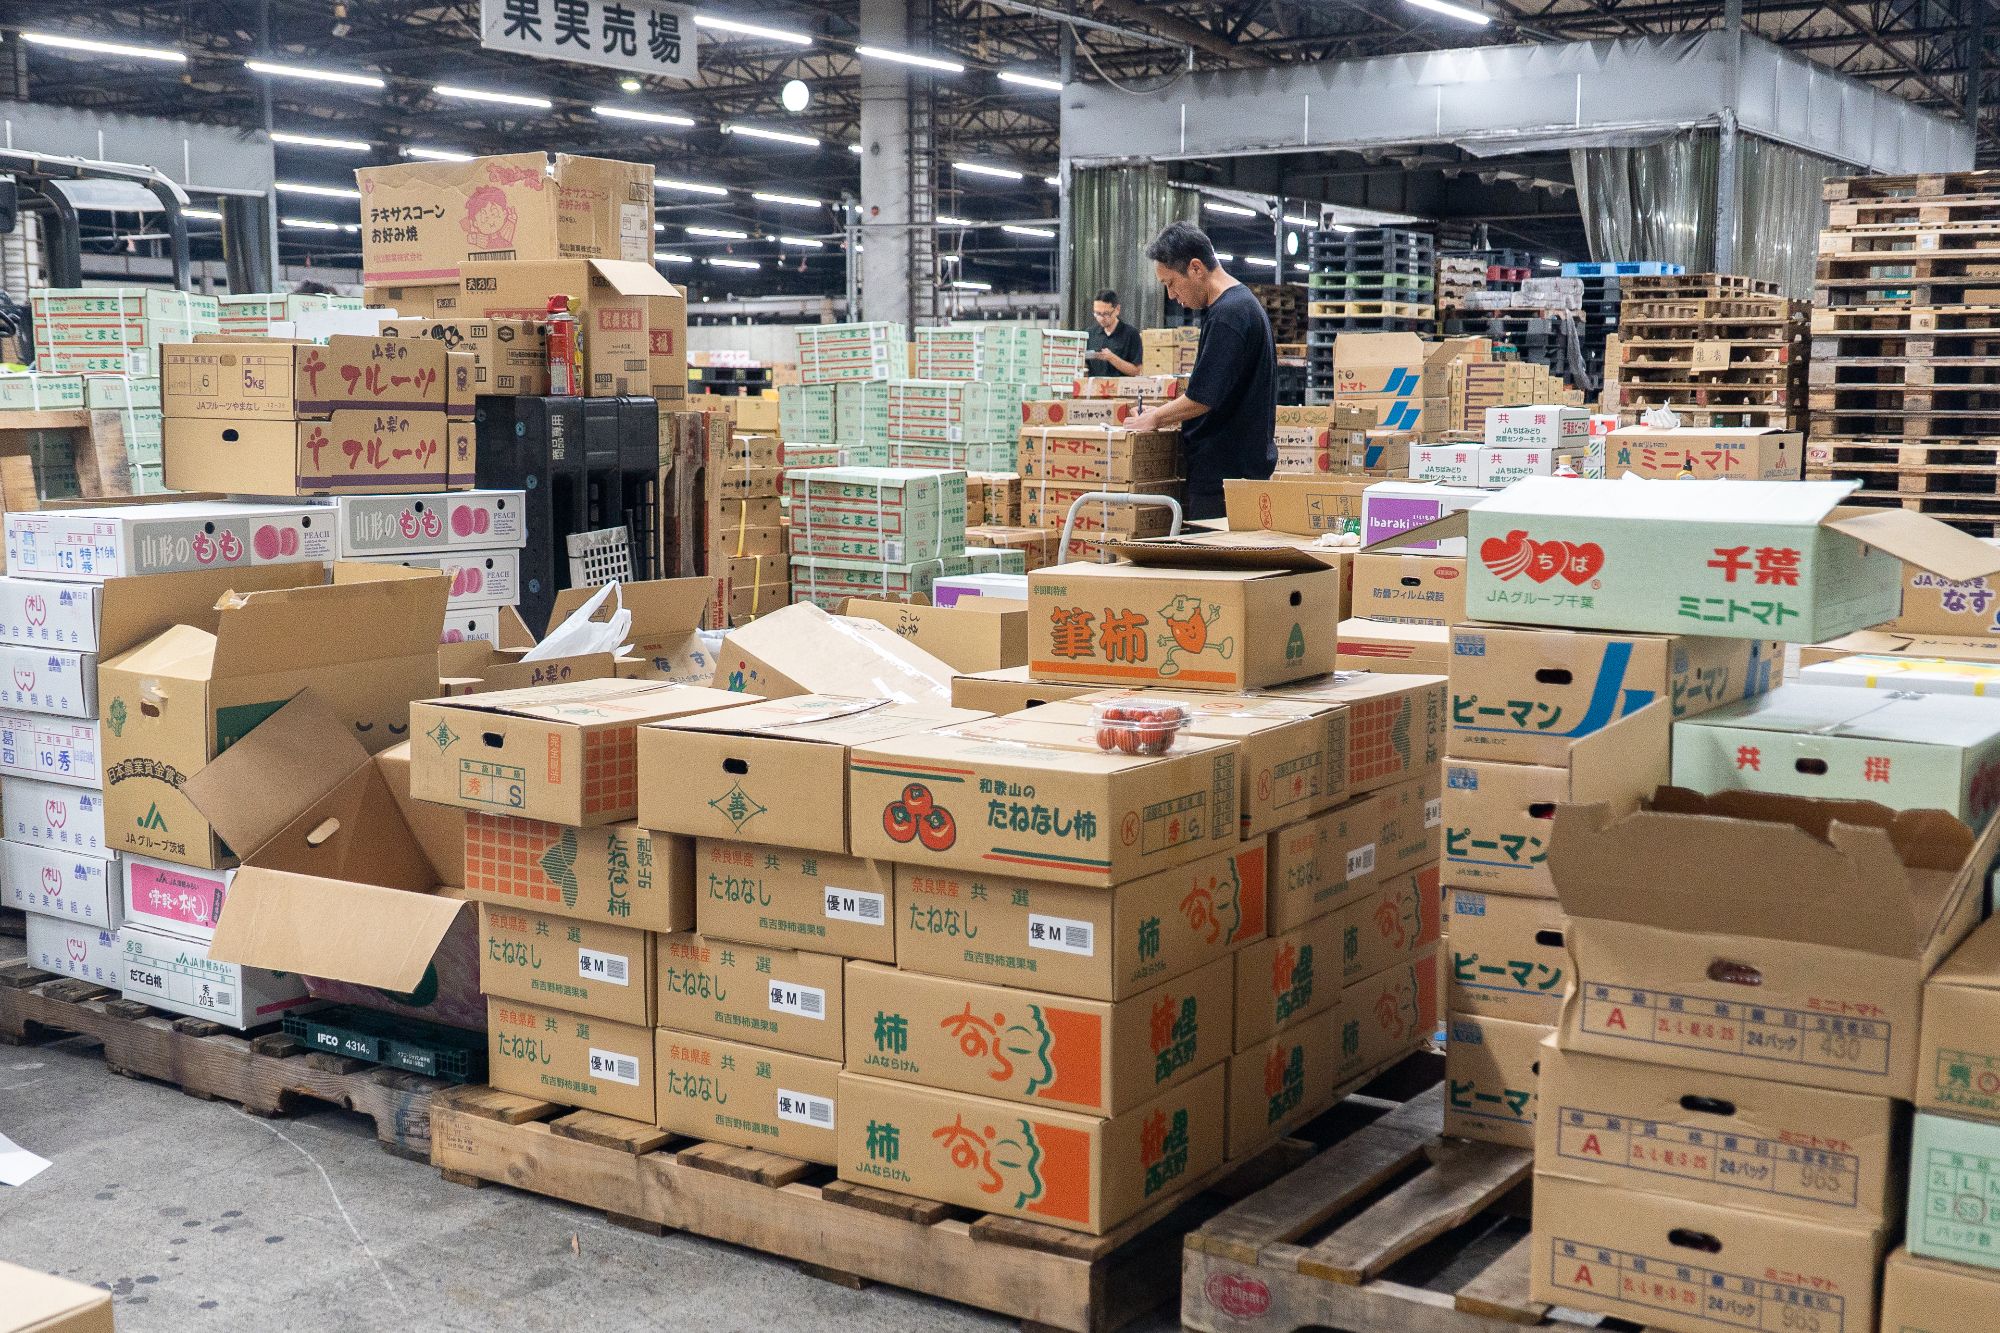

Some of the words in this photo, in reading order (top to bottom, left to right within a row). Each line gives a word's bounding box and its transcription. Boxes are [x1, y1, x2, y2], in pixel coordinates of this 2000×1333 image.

[503, 0, 681, 64] 果実売場
[371, 204, 445, 222] テキサスコーン
[371, 226, 423, 243] お好み焼
[84, 300, 119, 311] とまと
[241, 306, 268, 316] とまと
[85, 329, 119, 340] とまと
[371, 342, 408, 361] 山梨の
[87, 359, 122, 370] とまと
[202, 374, 210, 387] 6
[244, 369, 264, 390] 5kg
[341, 363, 437, 398] フルーツ
[1340, 382, 1366, 391] トマト
[196, 401, 261, 412] JAフルーツやまなし
[374, 416, 410, 434] 山梨の
[1502, 427, 1541, 435] JAちばみどり
[551, 414, 565, 460] 商品専用
[1052, 439, 1096, 454] トマト
[342, 437, 437, 470] フルーツ
[810, 455, 834, 465] とまと
[1641, 449, 1740, 472] ミニトマト
[1052, 464, 1095, 479] トマト
[1425, 466, 1462, 474] JAちばみどり
[1495, 467, 1534, 475] JAちばみどり
[843, 486, 877, 499] とまと
[355, 508, 442, 541] 山形のもも
[841, 514, 877, 527] とまと
[1370, 516, 1410, 529] Ibaraki
[304, 531, 330, 539] PEACH
[141, 530, 244, 568] 山形のもも
[841, 542, 877, 555] とまと
[58, 551, 73, 568] 15
[1707, 545, 1803, 587] 千葉
[487, 571, 509, 579] PEACH
[846, 571, 882, 584] とまと
[1487, 589, 1595, 610] JAグループ千葉
[1943, 589, 1993, 613] なす
[1678, 596, 1800, 626] ミニトマト
[467, 632, 490, 641] PEACH
[1050, 606, 1149, 663] 筆柿
[1454, 695, 1562, 729] ピーマン
[41, 751, 53, 766] 16
[58, 751, 71, 771] 秀
[1736, 745, 1761, 771] 共
[468, 777, 481, 796] 秀
[509, 785, 522, 808] S
[979, 778, 1035, 799] 和歌山の
[728, 792, 748, 821] 善
[988, 799, 1097, 842] たねなし柿
[1446, 828, 1548, 863] ピーマン
[711, 847, 754, 867] 奈良県産
[607, 833, 632, 918] たねなし柿
[708, 873, 771, 907] たねなし
[912, 875, 959, 898] 奈良県産
[827, 894, 840, 912] 優
[844, 899, 855, 912] M
[489, 912, 528, 934] 奈良県産
[910, 902, 978, 939] たねなし
[1031, 922, 1045, 941] 優
[1049, 927, 1061, 941] M
[1137, 916, 1161, 963] 柿
[488, 936, 542, 970] たねなし
[670, 941, 711, 963] 奈良県産
[580, 955, 591, 972] 優
[594, 958, 604, 972] M
[1455, 952, 1562, 990] ピーマン
[202, 984, 210, 997] 秀
[667, 966, 726, 1002] たねなし
[770, 987, 784, 1005] 優
[786, 991, 797, 1005] M
[1807, 998, 1884, 1017] ミニトマト
[499, 1008, 537, 1030] 奈良県産
[1606, 1007, 1627, 1031] A
[317, 1033, 338, 1047] IFCO
[874, 1010, 909, 1055] 柿
[1747, 1030, 1798, 1052] 24パック
[498, 1031, 551, 1065] たねなし
[670, 1044, 712, 1067] 奈良県産
[590, 1056, 602, 1071] 優
[605, 1058, 615, 1072] M
[864, 1053, 919, 1074] JAならけん
[667, 1069, 727, 1105] たねなし
[778, 1096, 792, 1114] 優
[795, 1101, 806, 1115] M
[1451, 1079, 1530, 1117] ピーマ
[865, 1120, 900, 1164] 柿
[1582, 1133, 1602, 1156] A
[1780, 1128, 1853, 1153] ミニトマト
[856, 1162, 911, 1183] JAならけん
[1720, 1158, 1768, 1181] 24パック
[1574, 1264, 1593, 1287] A
[1764, 1267, 1839, 1292] ミニトマト
[1708, 1296, 1756, 1318] 24パック
